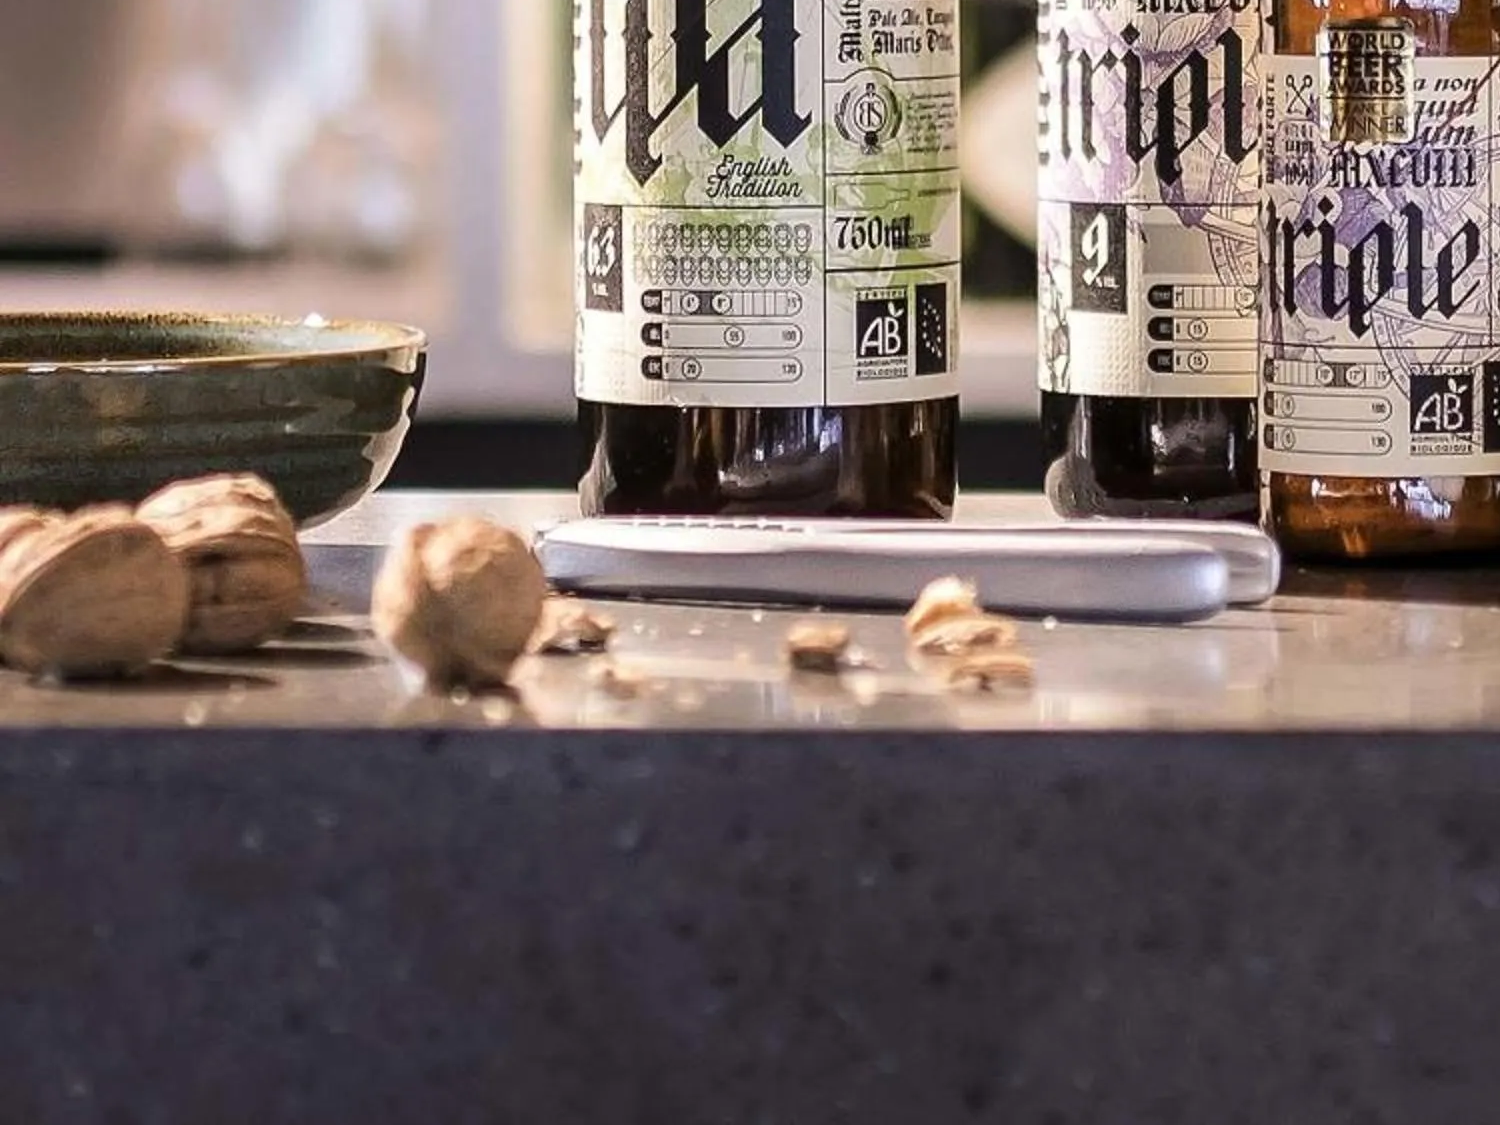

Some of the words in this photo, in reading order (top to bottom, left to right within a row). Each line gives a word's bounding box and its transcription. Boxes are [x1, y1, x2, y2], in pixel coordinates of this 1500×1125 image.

[1328, 32, 1406, 50] WORLD
[1328, 52, 1406, 77] BEER
[1328, 78, 1406, 94] AWARDS
[716, 154, 793, 179] English
[705, 175, 803, 198] Tradition
[861, 317, 901, 355] AB
[1414, 392, 1464, 431] AB
